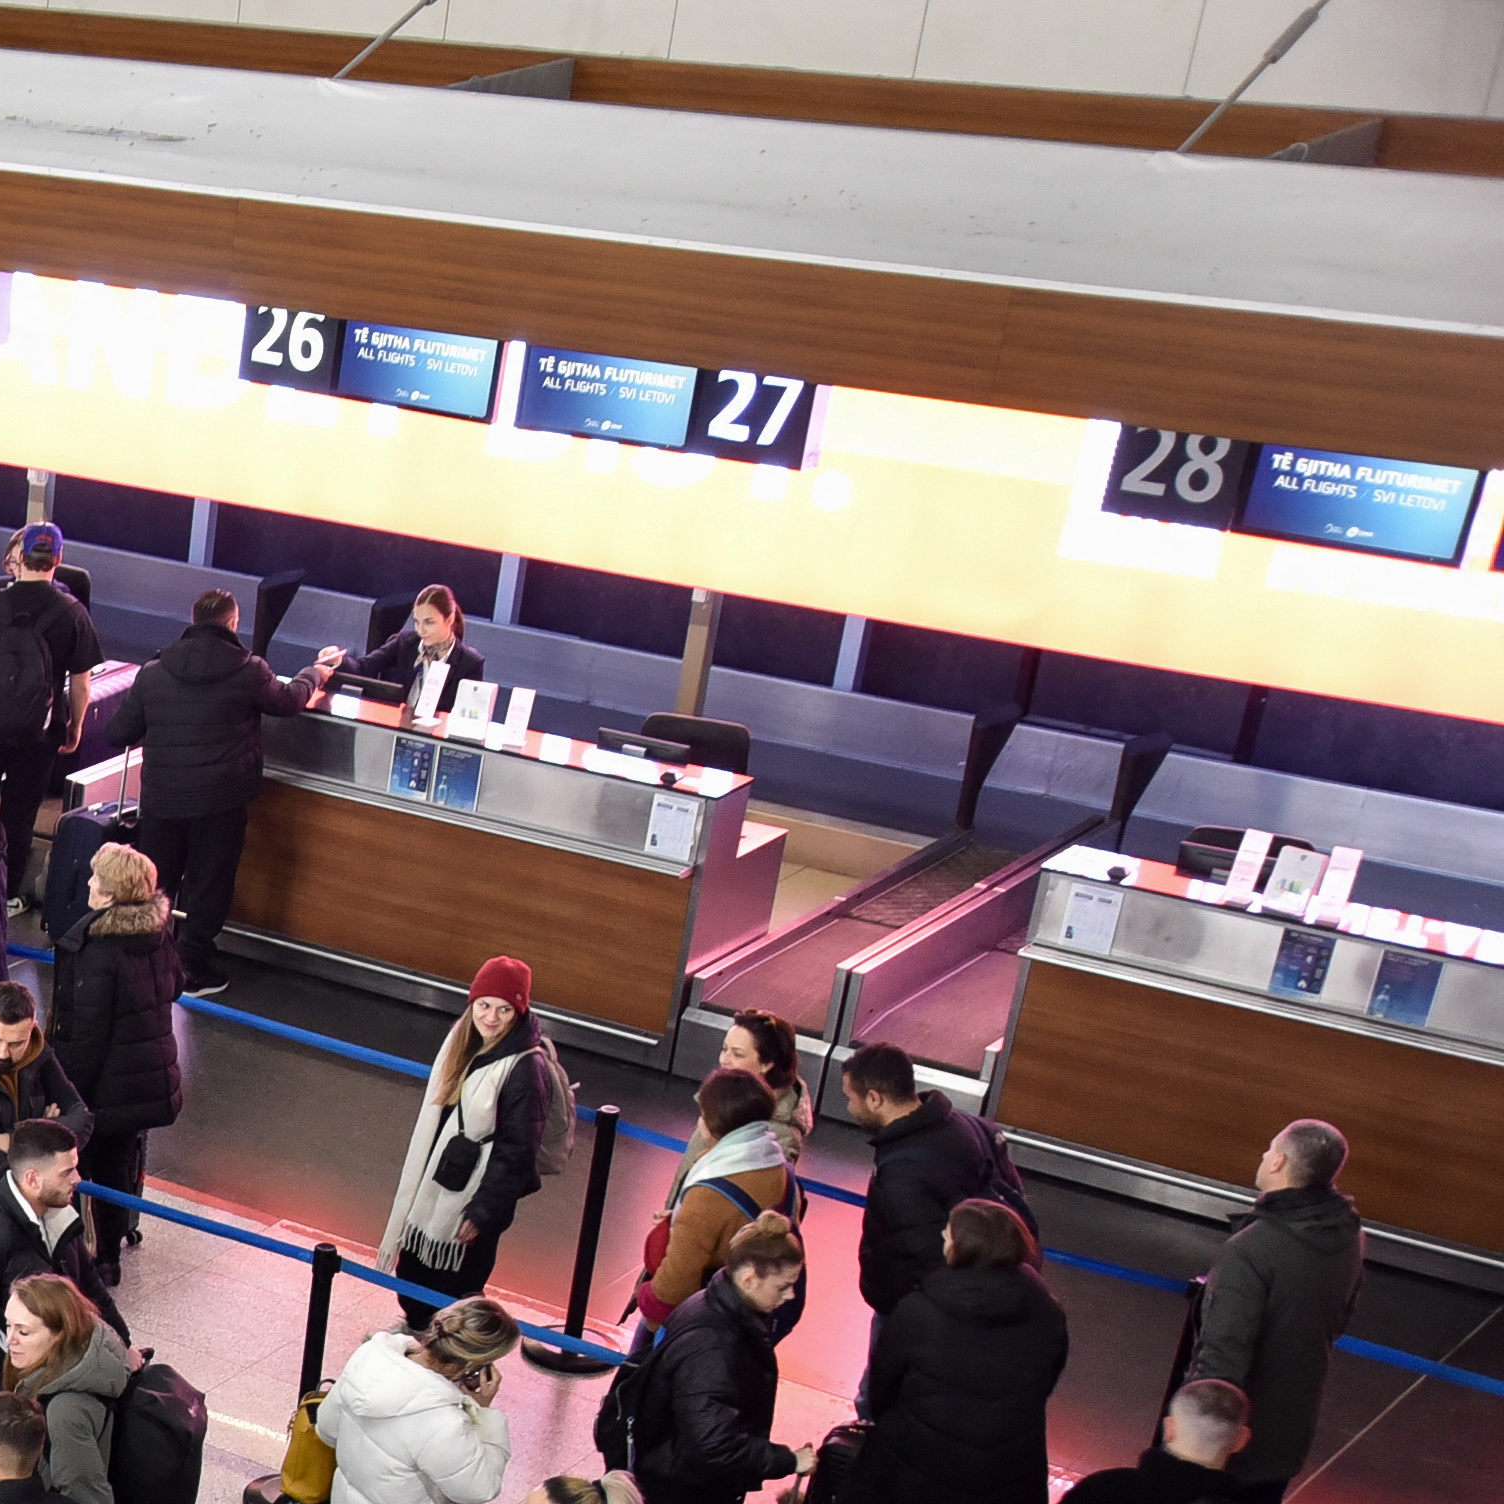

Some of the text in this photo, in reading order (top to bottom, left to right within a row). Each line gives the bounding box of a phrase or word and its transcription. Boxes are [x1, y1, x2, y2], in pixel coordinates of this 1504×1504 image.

[250, 305, 325, 373] 26
[354, 327, 488, 363] TË GJITHA FLUTURIMET
[357, 347, 479, 377] ALL FLIGHTS SVI LETOVI
[538, 356, 687, 390] TË GJITHA FLUTURIMET
[542, 376, 676, 405] ALL FLIGHTS SVI LETOVI
[706, 369, 805, 446] 27
[1120, 426, 1231, 504] 28
[1272, 452, 1463, 495] TË GJITHA FLUTURIMET
[1273, 475, 1446, 511] ALL FLIGHTS SVI LETOVI
